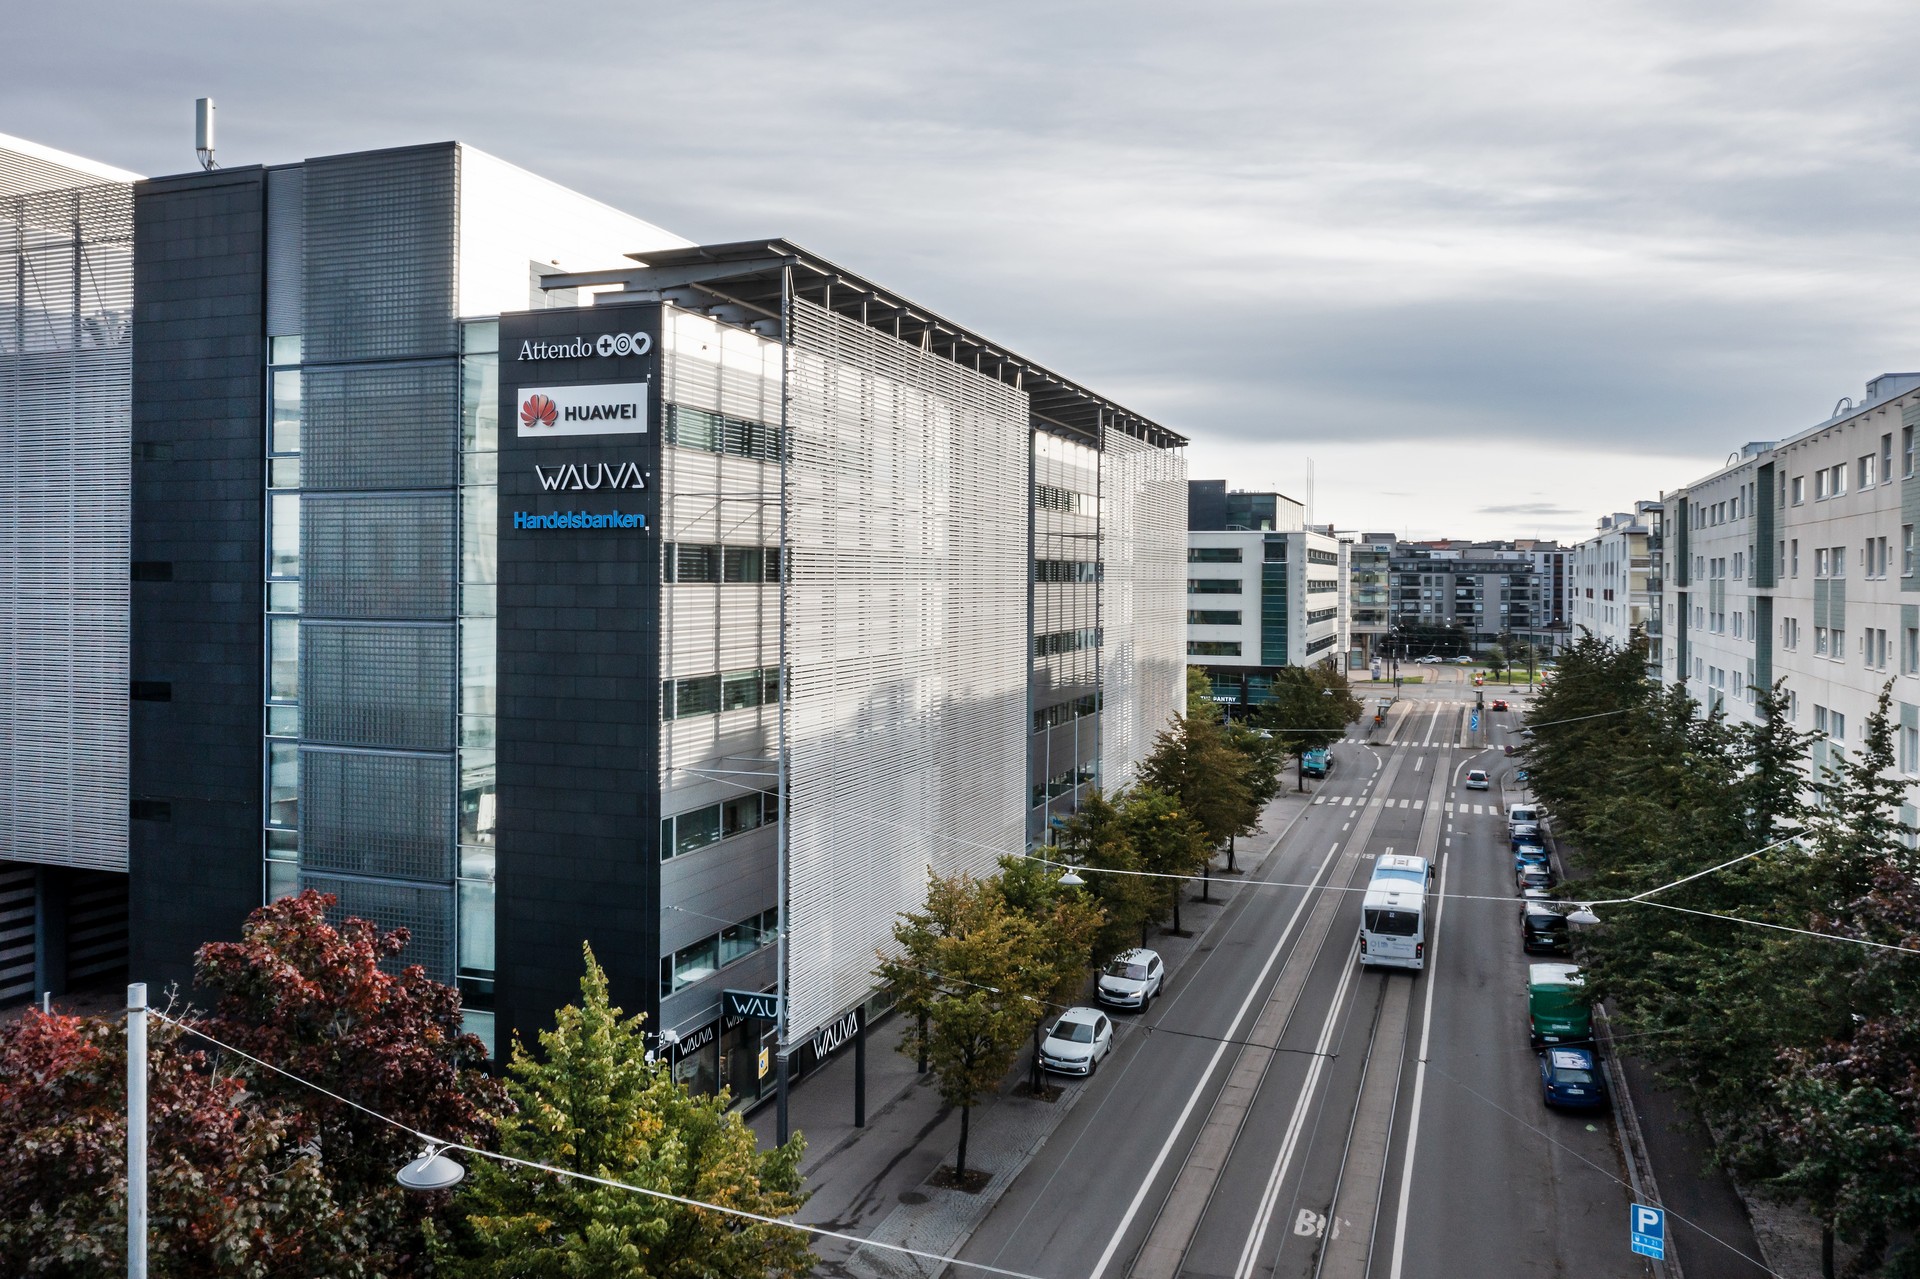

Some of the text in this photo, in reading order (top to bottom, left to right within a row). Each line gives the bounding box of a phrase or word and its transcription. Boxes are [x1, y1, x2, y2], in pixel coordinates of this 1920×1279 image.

[518, 337, 592, 360] Attendo
[565, 403, 637, 421] HUAWEI
[535, 462, 645, 490] WAUVA
[514, 510, 645, 529] Handelsbanken
[680, 1027, 713, 1056] WAUVA
[813, 1011, 858, 1060] WAUVA
[1638, 1207, 1659, 1233] P
